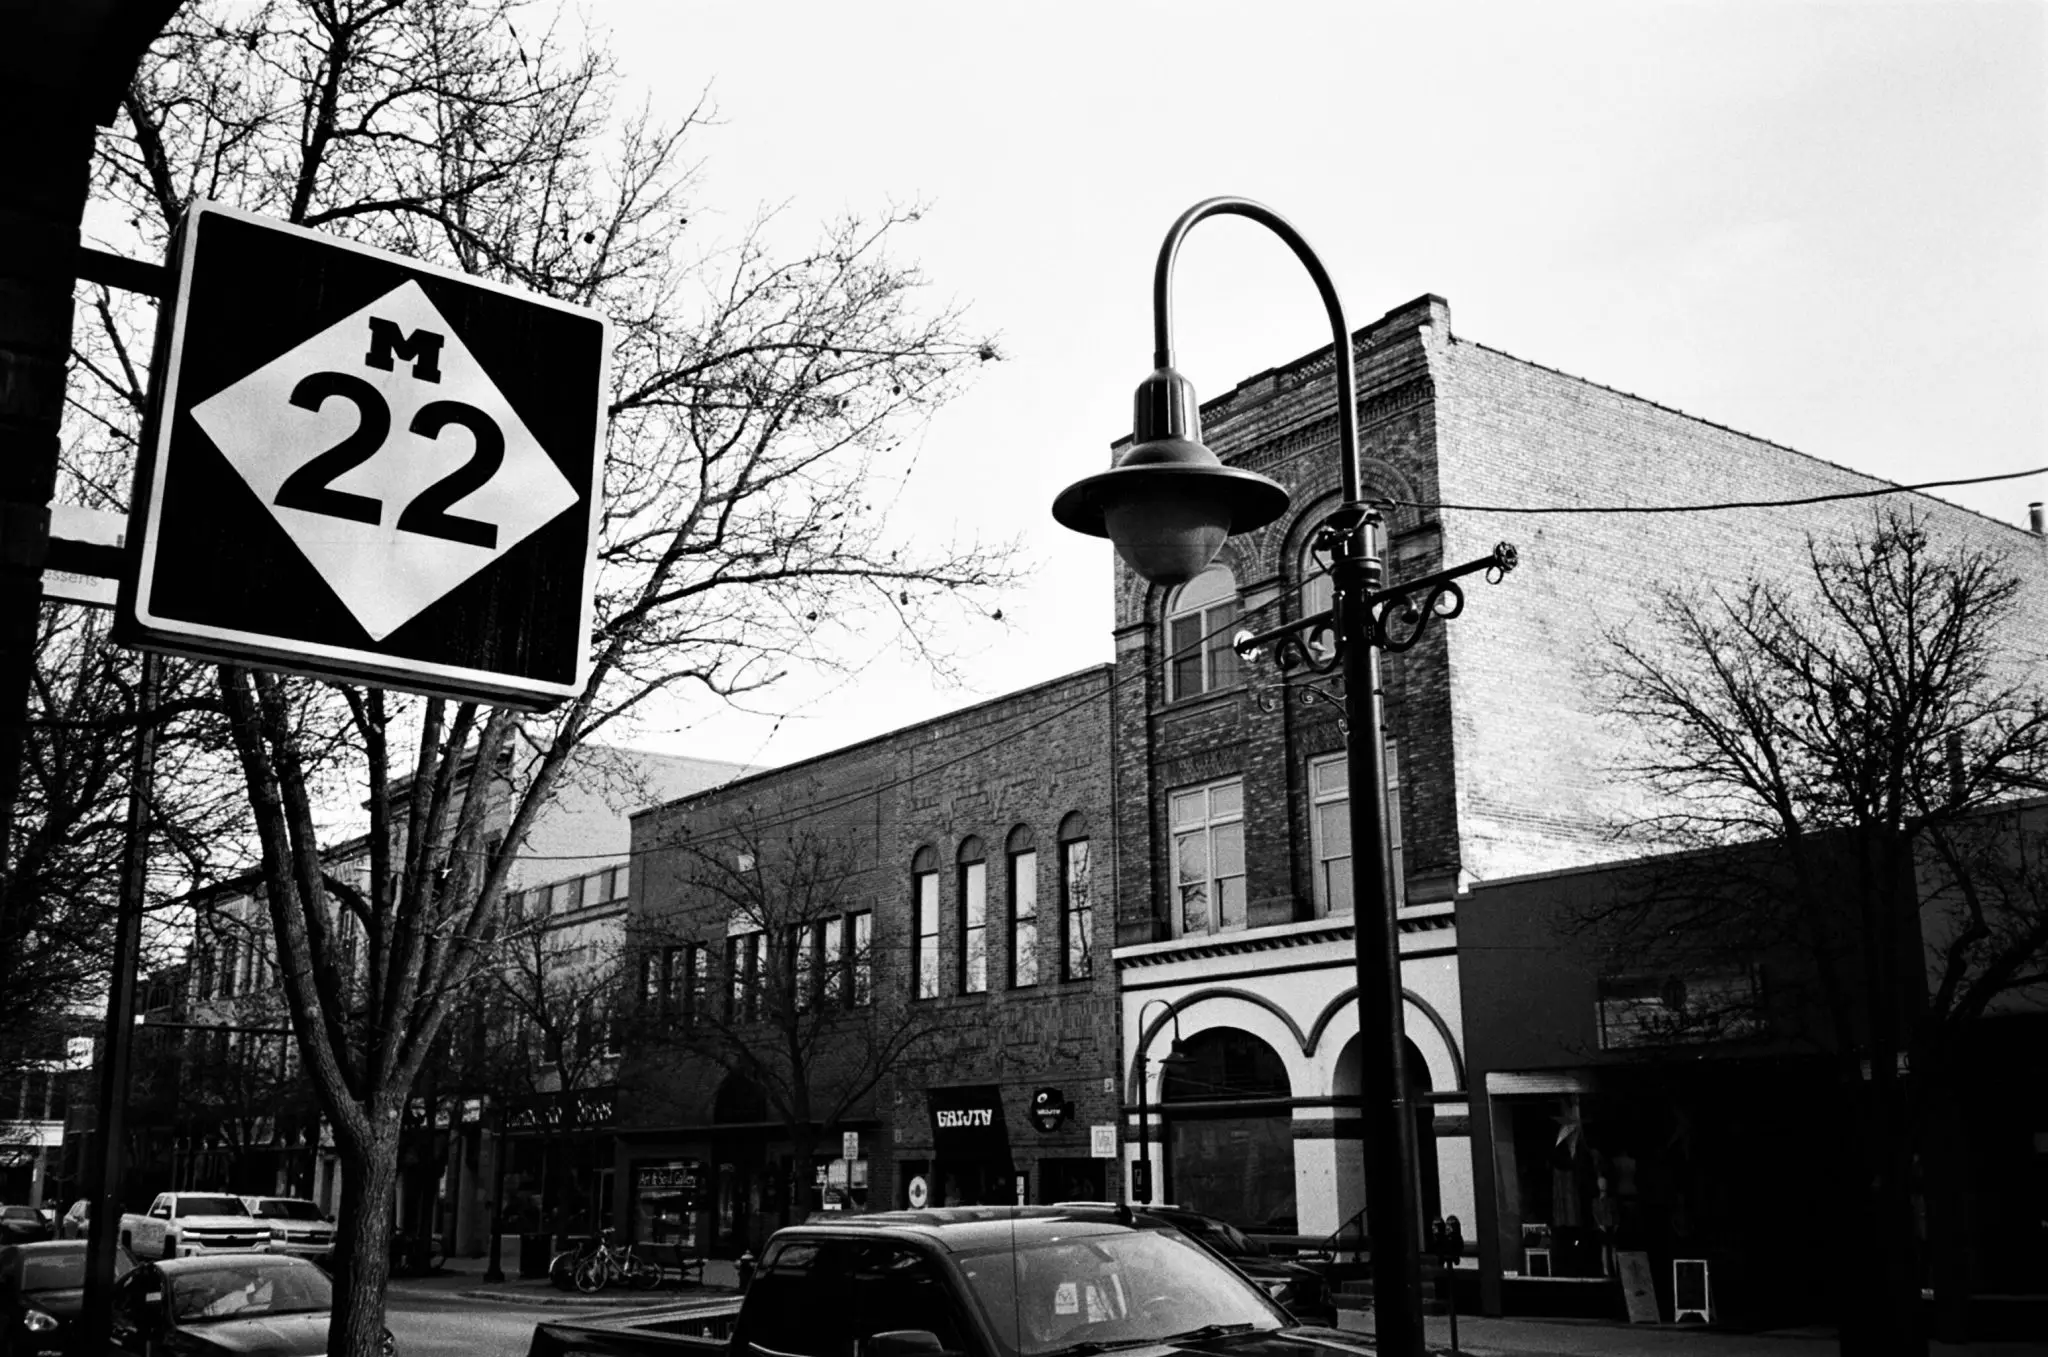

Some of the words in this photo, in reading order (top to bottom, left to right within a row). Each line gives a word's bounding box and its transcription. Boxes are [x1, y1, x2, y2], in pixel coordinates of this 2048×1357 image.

[365, 316, 444, 384] M
[273, 371, 505, 549] 22
[937, 1109, 992, 1127] GAIJIN
